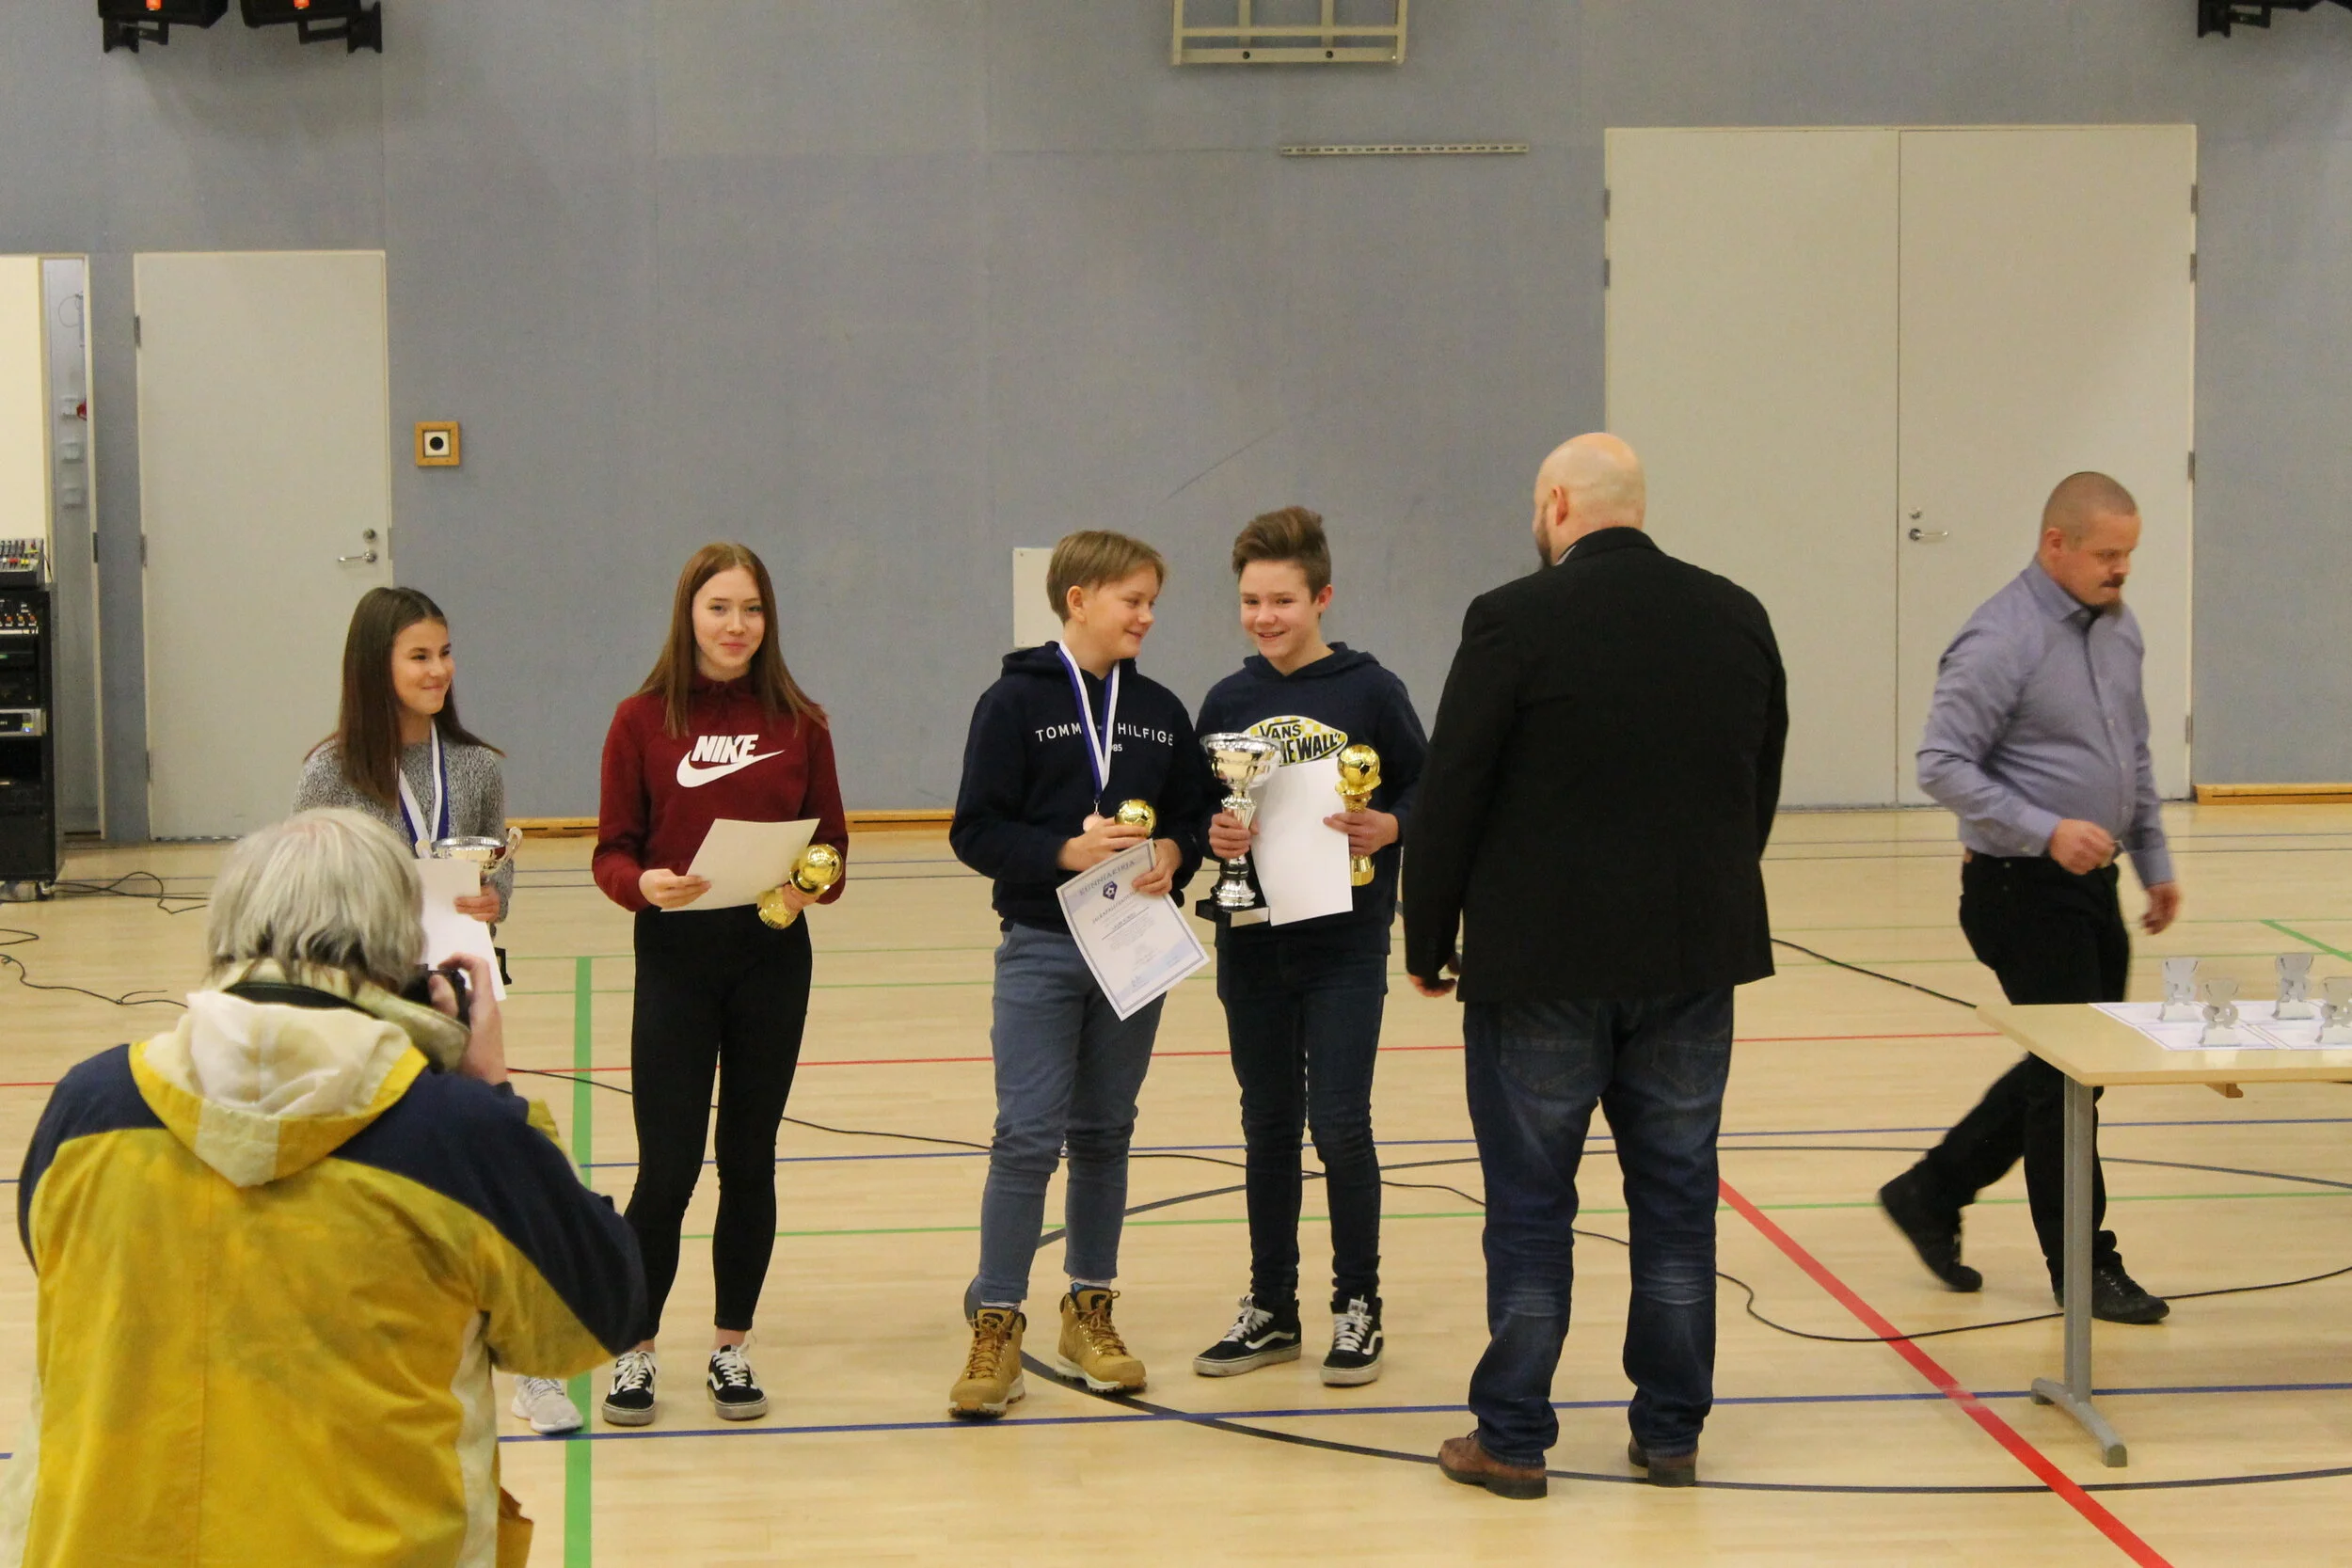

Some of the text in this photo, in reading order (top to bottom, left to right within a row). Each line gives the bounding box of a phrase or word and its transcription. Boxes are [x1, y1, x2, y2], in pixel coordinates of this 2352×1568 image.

[1035, 722, 1174, 746] TOMM HILFIGE
[1259, 720, 1301, 739] VANS
[691, 734, 759, 763] NIKE
